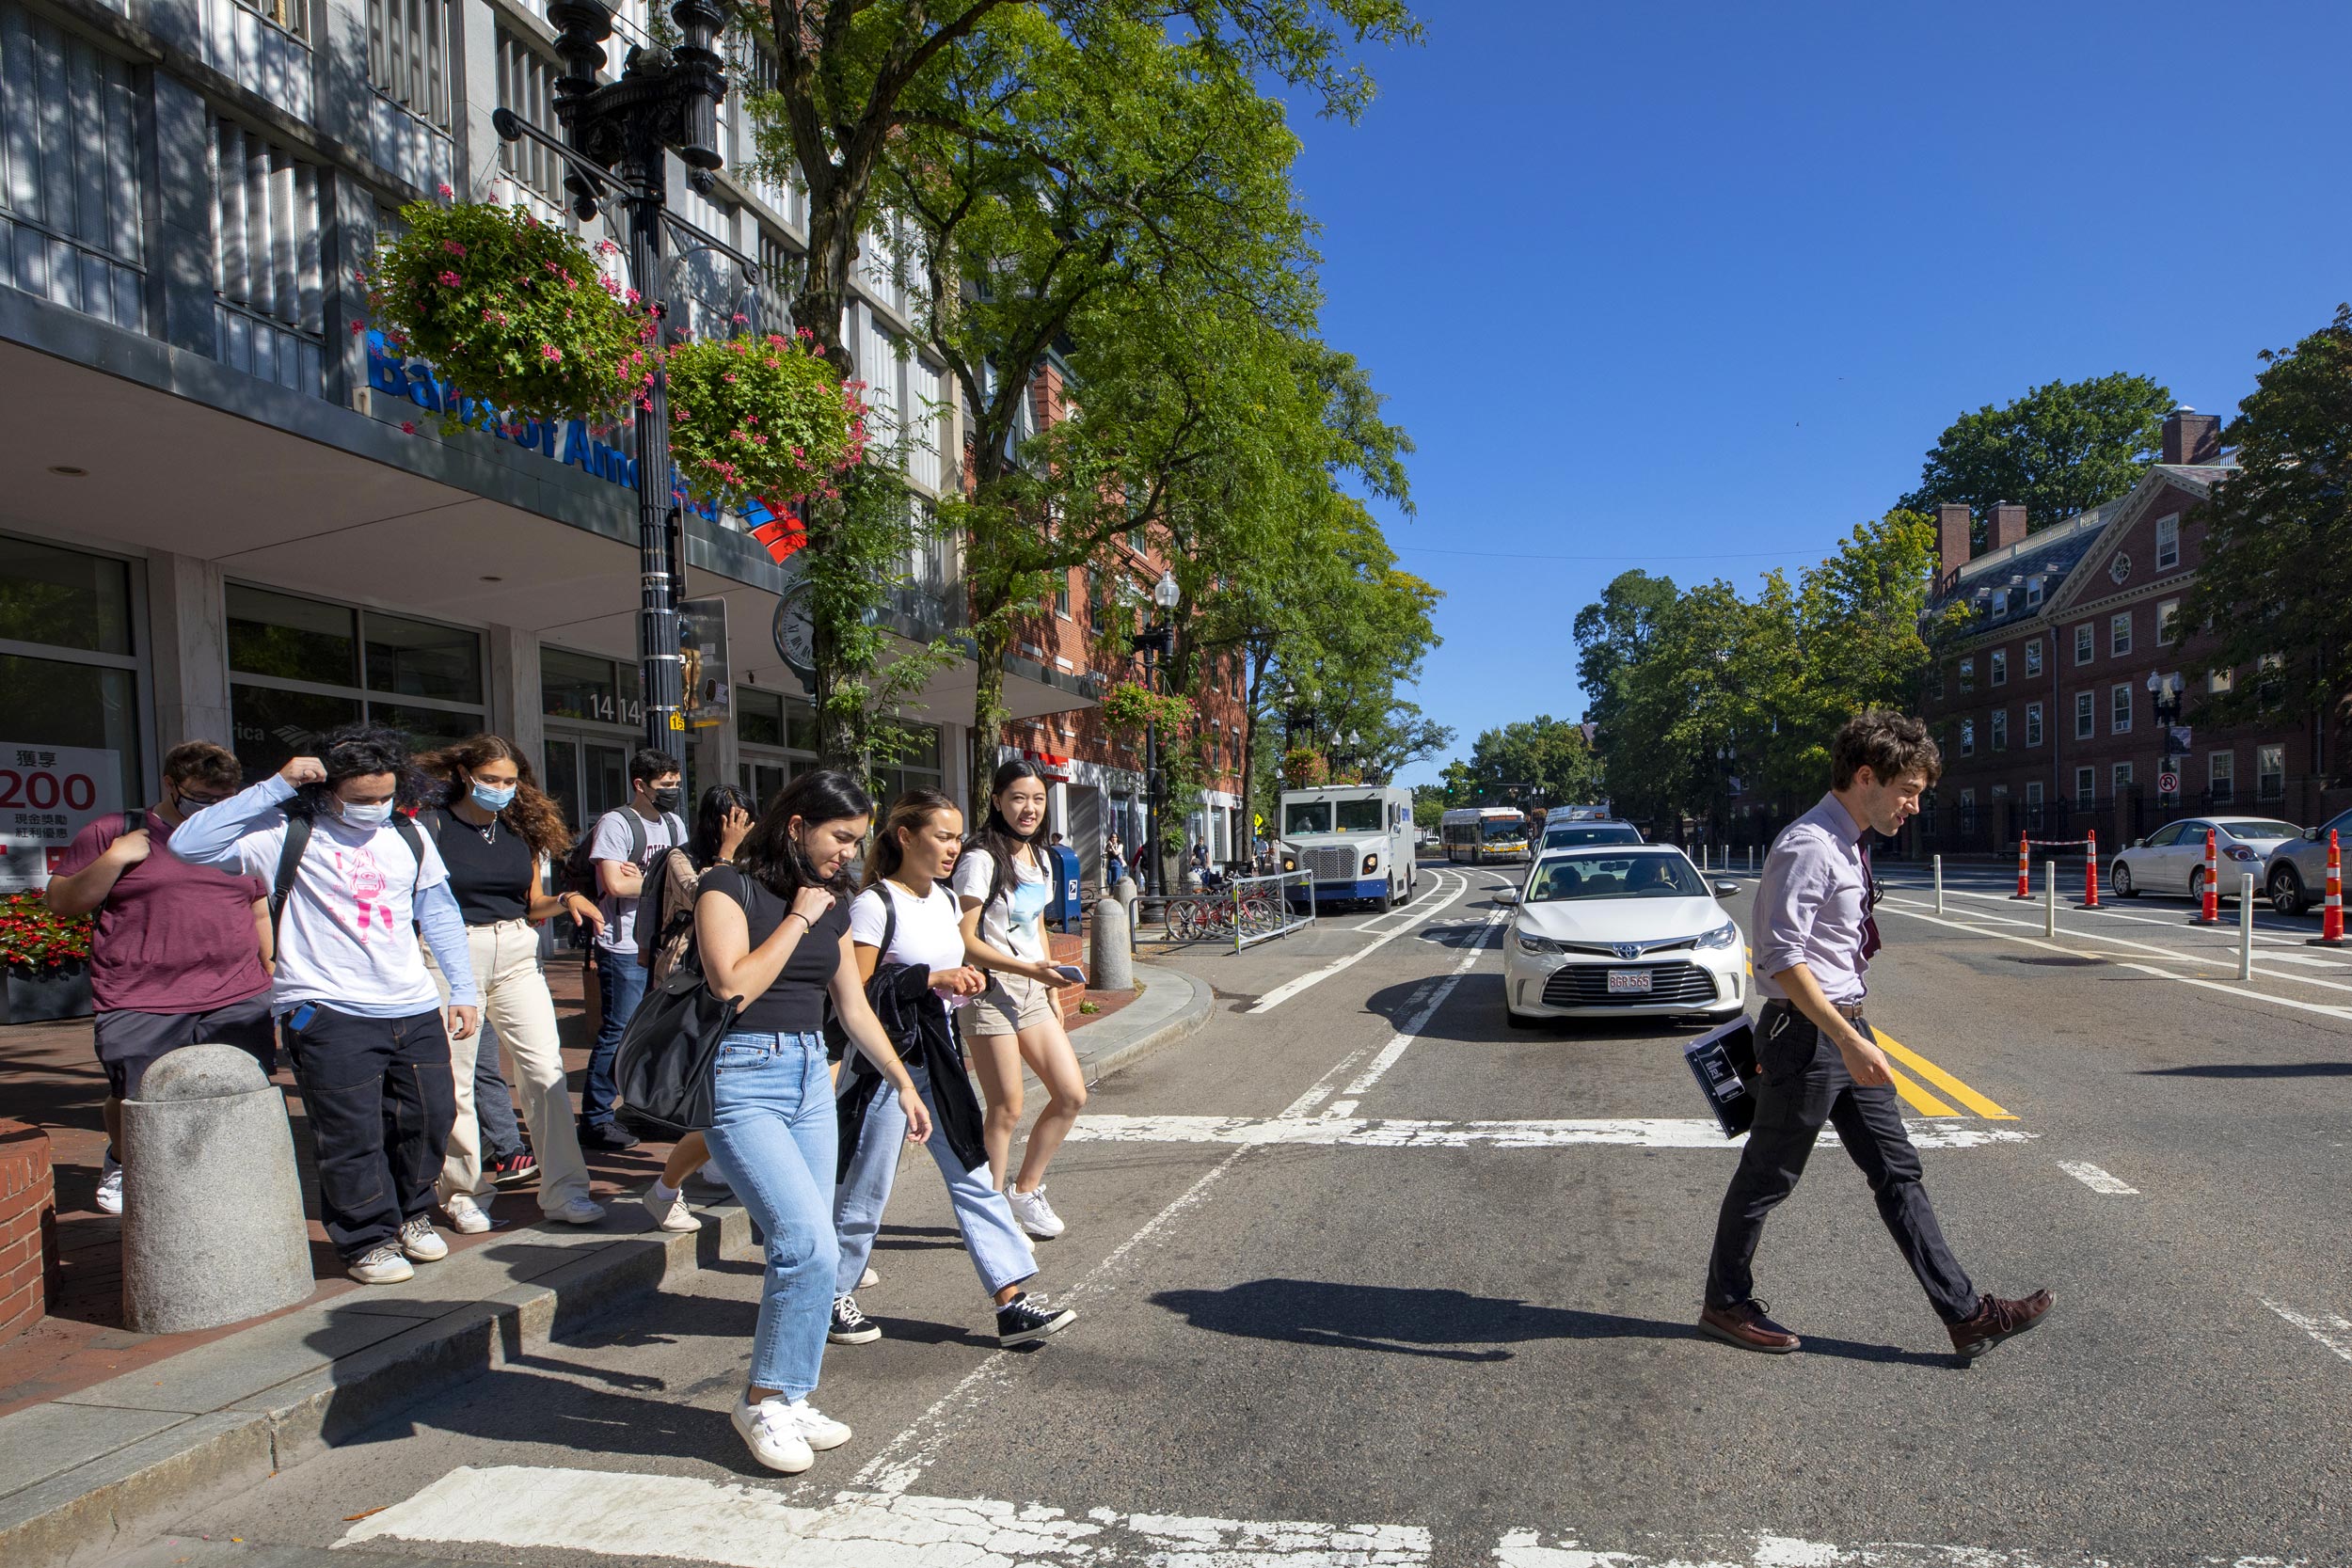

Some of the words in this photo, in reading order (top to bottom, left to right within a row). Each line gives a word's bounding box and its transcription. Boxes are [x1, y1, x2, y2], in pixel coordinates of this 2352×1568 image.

[16, 750, 57, 768] 獲享
[0, 769, 96, 811] 200
[1630, 975, 1649, 987] 565
